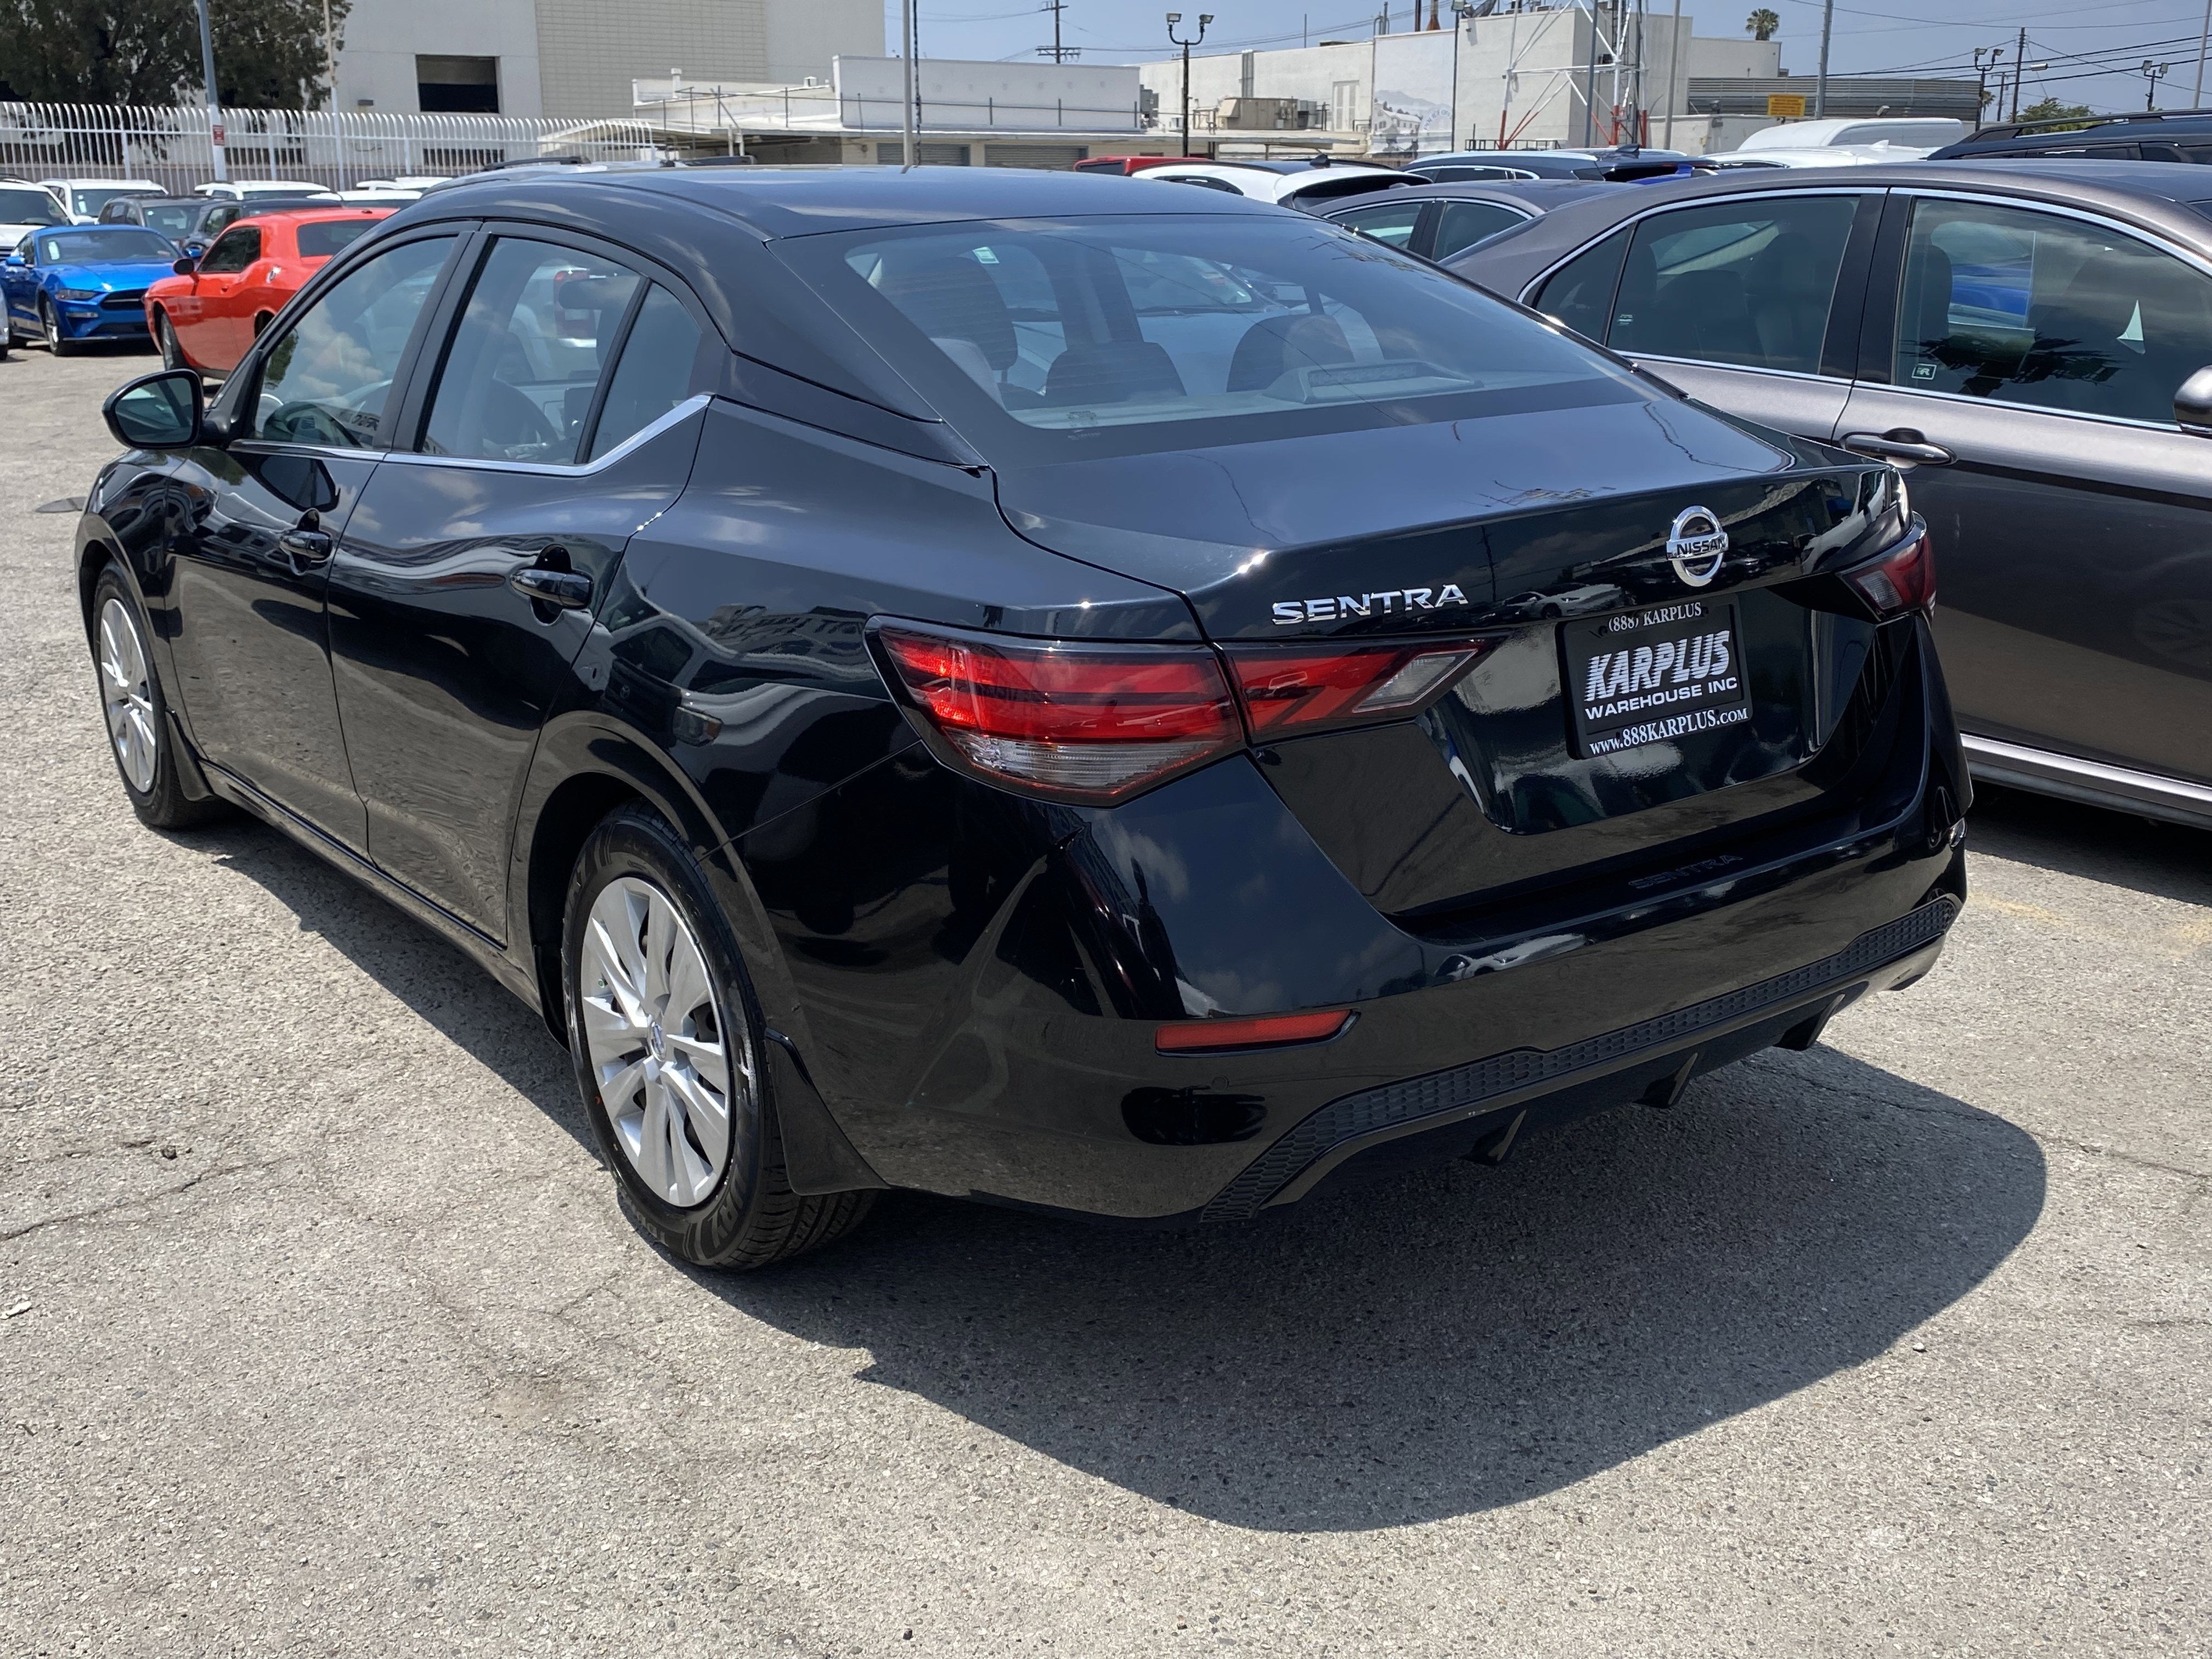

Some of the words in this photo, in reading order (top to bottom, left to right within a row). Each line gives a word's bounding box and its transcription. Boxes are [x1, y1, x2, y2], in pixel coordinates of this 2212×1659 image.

[1677, 538, 1725, 555] NISSAN
[1272, 583, 1469, 625] SENTRA
[1609, 615, 1639, 632] (888)
[1643, 602, 1702, 627] KARPLUS
[1583, 630, 1730, 702] KARPLUS
[1584, 684, 1703, 720] WAREHOUSE
[1708, 676, 1738, 694] INC
[1628, 855, 1743, 889] SENTRA
